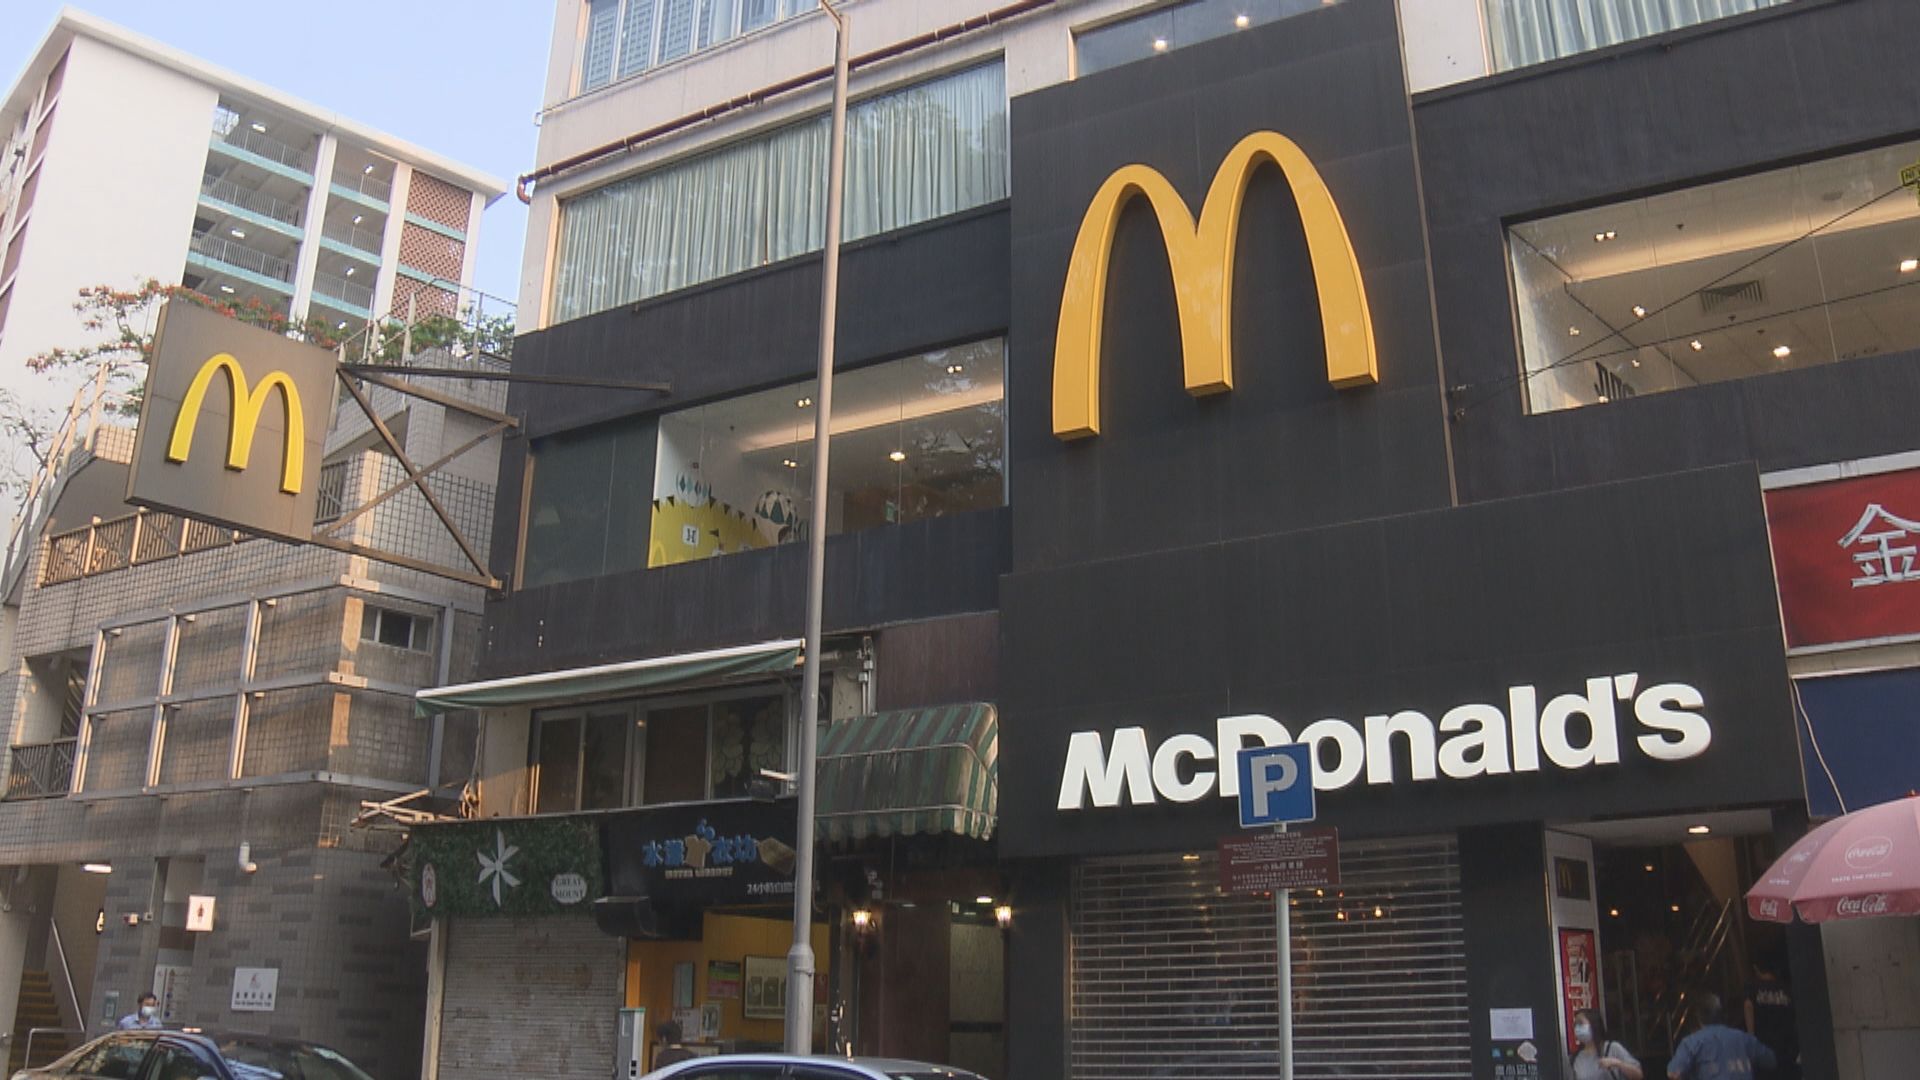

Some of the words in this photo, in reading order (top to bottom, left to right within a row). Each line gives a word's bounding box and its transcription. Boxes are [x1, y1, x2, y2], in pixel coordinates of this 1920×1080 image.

[1838, 503, 1920, 588] 金
[1057, 673, 1711, 808] McDonald's
[1250, 754, 1298, 817] P
